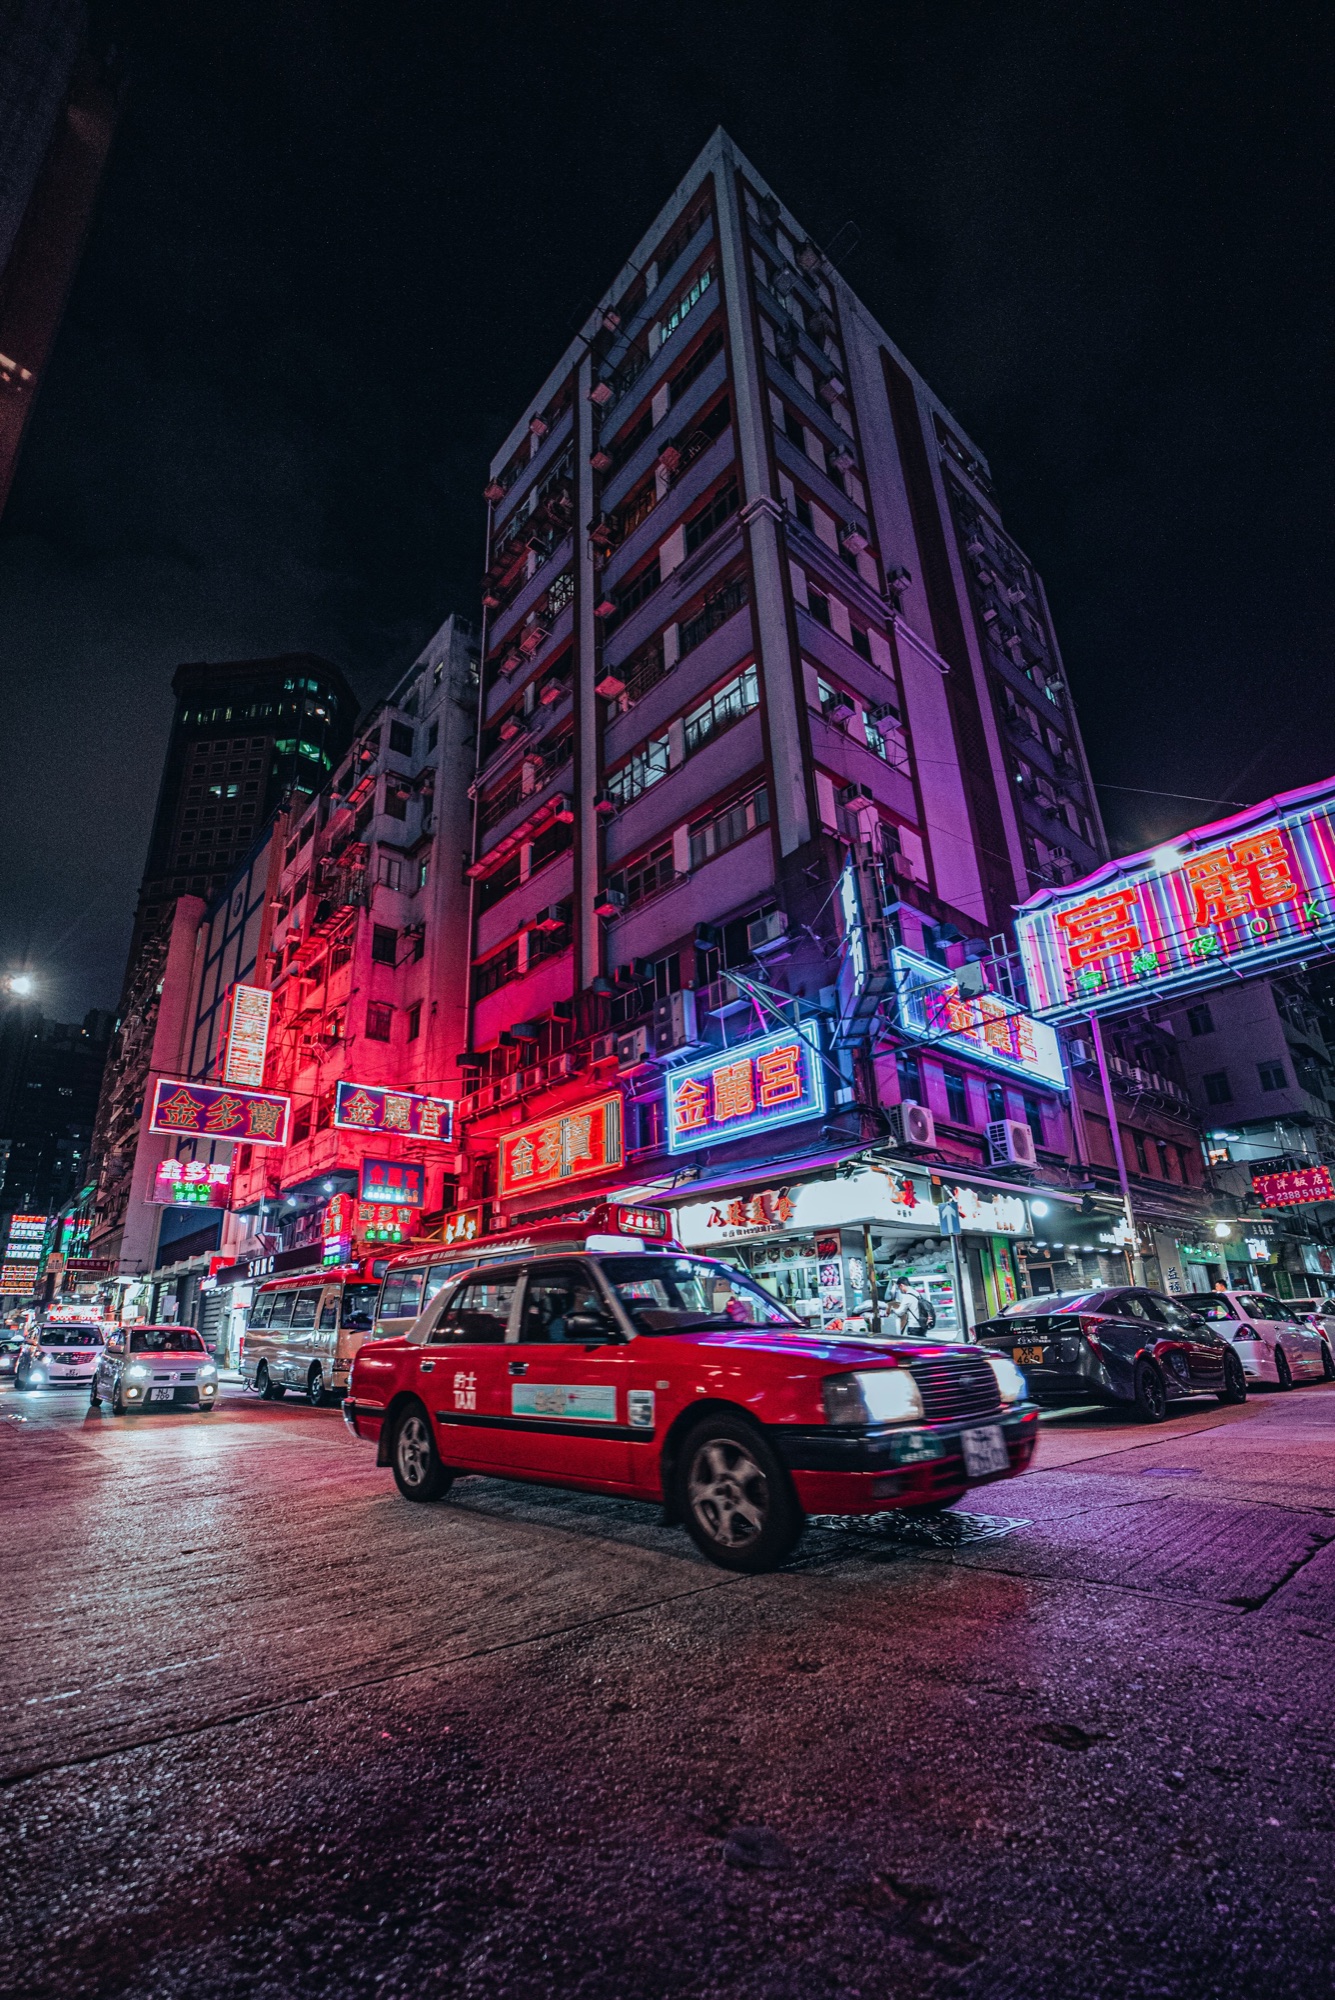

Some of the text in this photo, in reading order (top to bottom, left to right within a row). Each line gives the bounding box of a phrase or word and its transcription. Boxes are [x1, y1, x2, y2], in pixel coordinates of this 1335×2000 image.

[674, 1045, 801, 1132] 金麗宮
[158, 1088, 284, 1139] 金多寶
[343, 1089, 447, 1136] 金麗宮
[510, 1115, 593, 1181] 金多寶
[160, 1159, 230, 1184] 金多寶
[1276, 1186, 1328, 1202] 2388 5184
[1021, 1347, 1034, 1356] XR
[453, 1372, 478, 1390] 的士
[453, 1390, 477, 1410] TAXI
